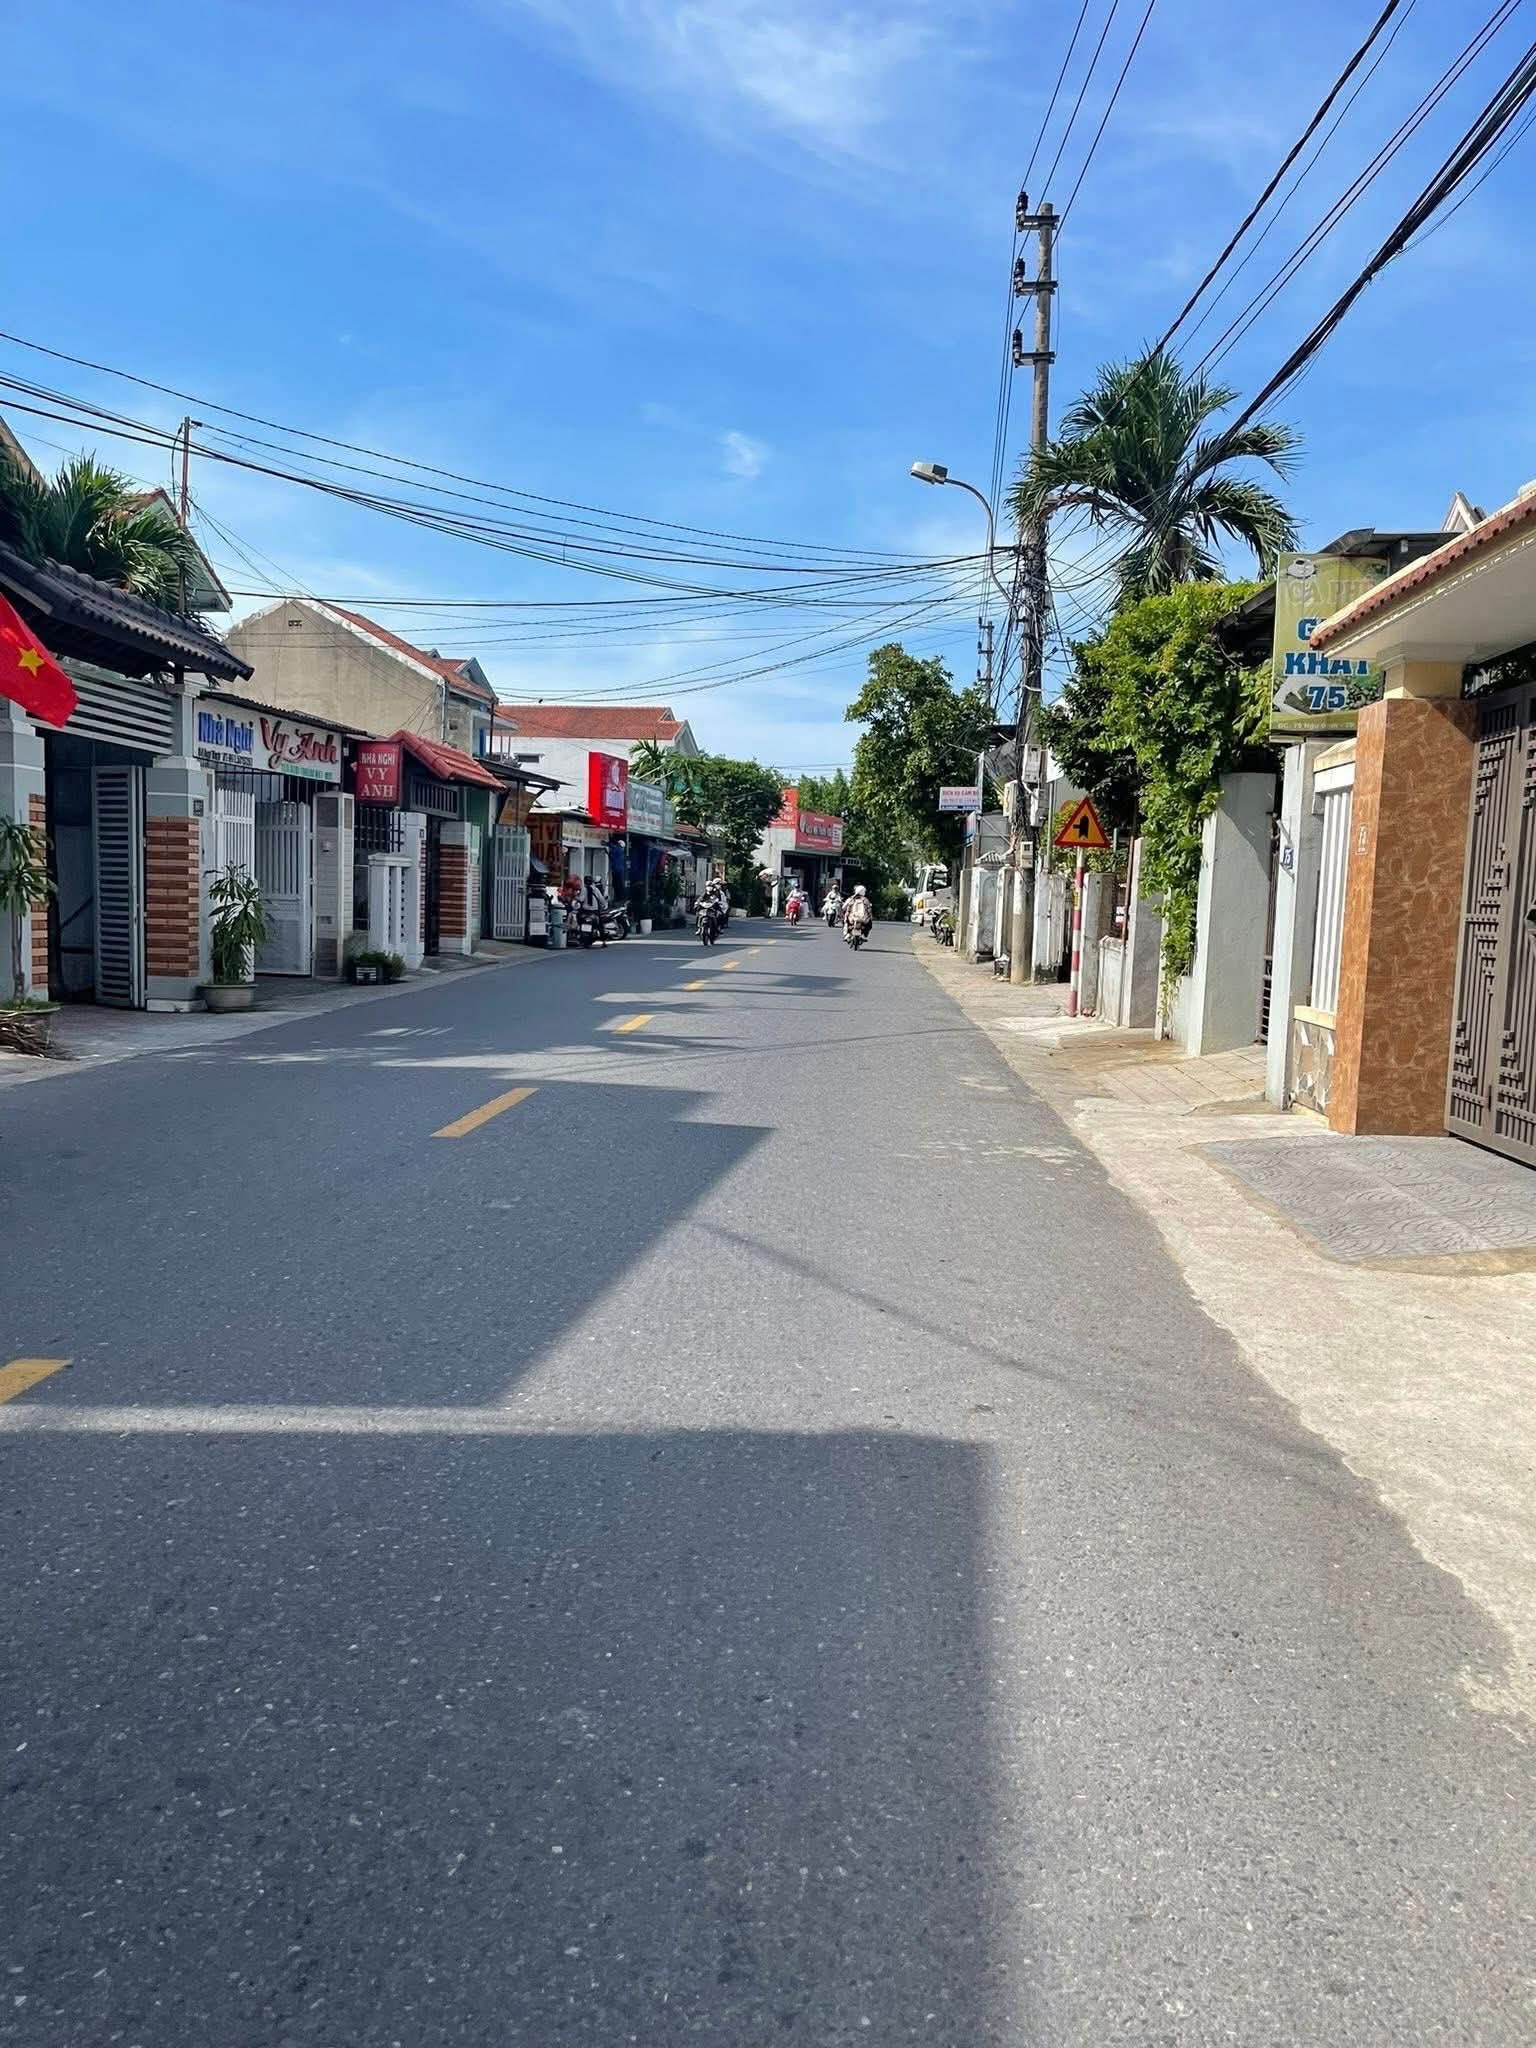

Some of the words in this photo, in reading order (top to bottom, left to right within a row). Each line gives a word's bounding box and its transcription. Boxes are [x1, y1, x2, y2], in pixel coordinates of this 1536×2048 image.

[1308, 686, 1346, 708] 75
[259, 717, 289, 769] Vy
[288, 728, 338, 764] Anh
[366, 767, 388, 780] VY
[360, 783, 394, 797] ANH
